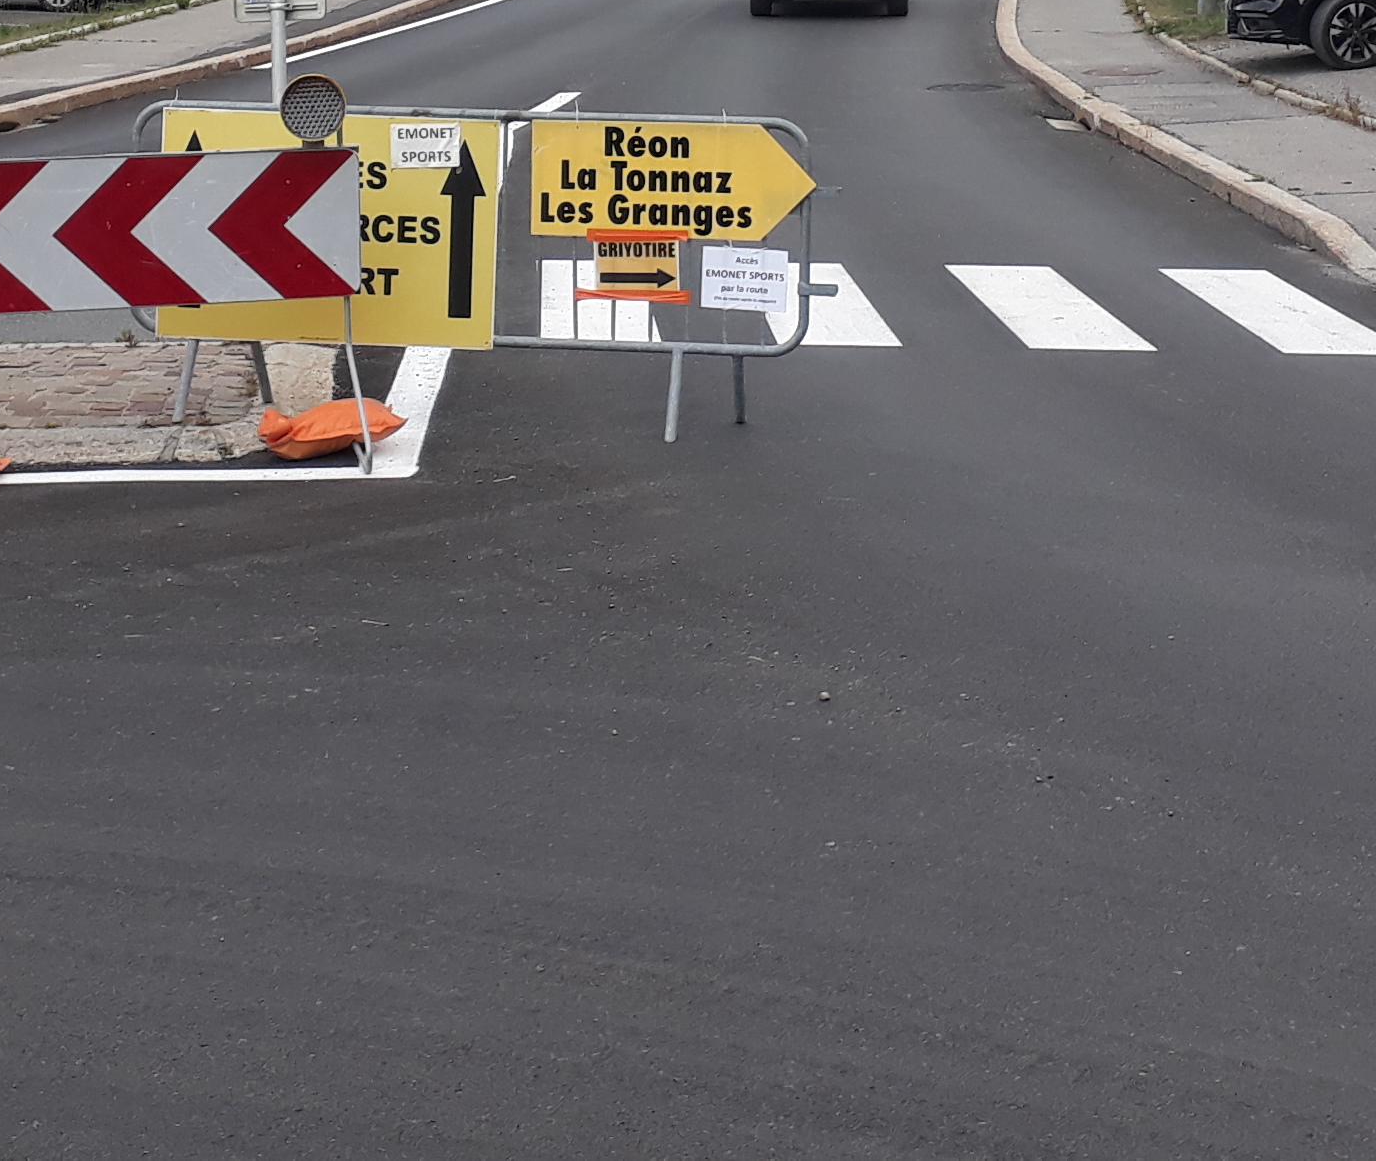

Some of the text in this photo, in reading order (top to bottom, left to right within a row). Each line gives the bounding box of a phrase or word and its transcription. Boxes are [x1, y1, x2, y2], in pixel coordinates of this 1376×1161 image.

[397, 127, 455, 140] EMONET
[603, 126, 690, 159] Réon
[401, 150, 452, 163] SPORTS
[359, 161, 388, 190] S
[561, 159, 733, 194] La Tonnaz
[540, 192, 753, 236] Les Granges
[597, 241, 676, 258] GRIYOTIRE
[735, 256, 759, 265] Accès
[705, 268, 785, 282] EMONET SPORTS
[720, 284, 769, 295] par la route
